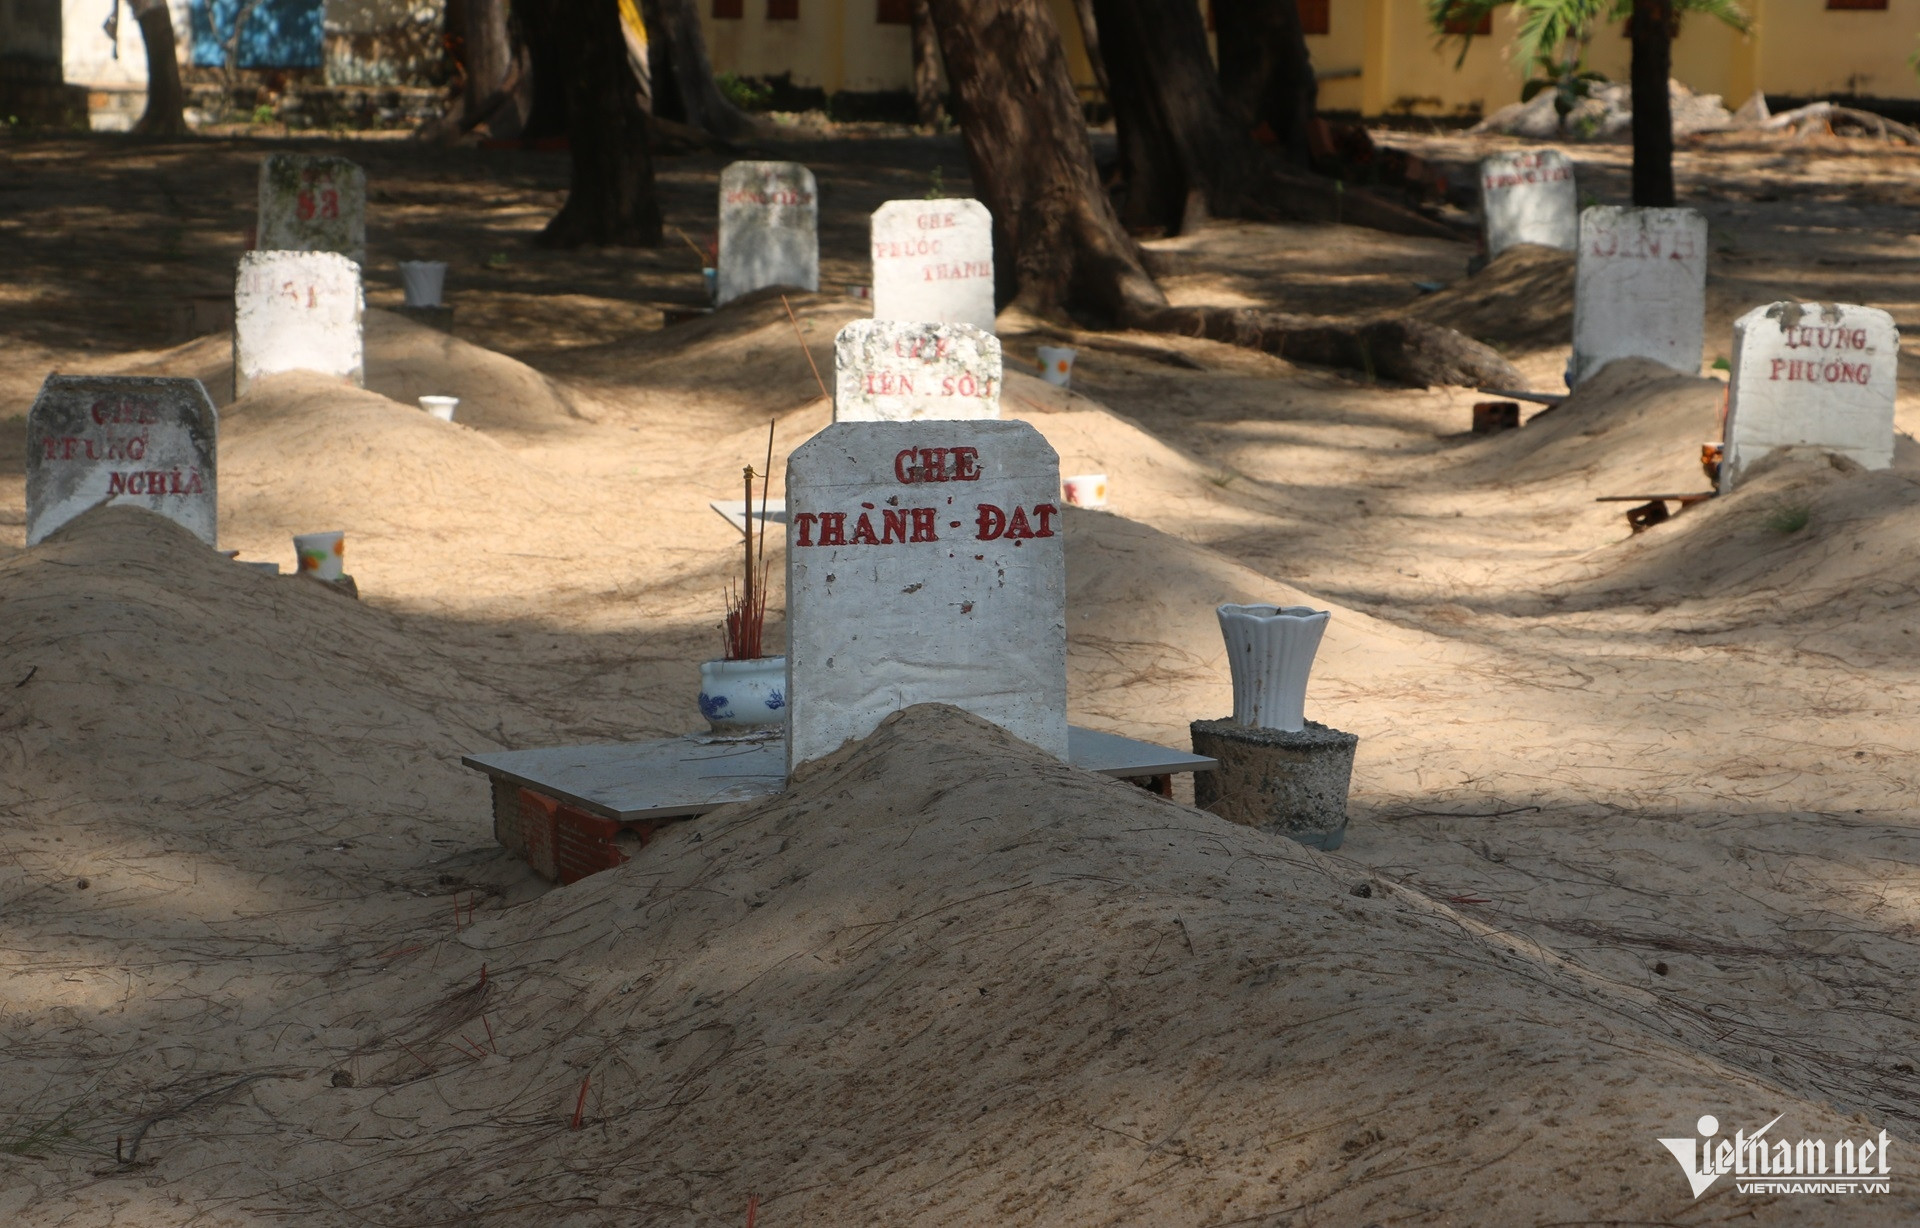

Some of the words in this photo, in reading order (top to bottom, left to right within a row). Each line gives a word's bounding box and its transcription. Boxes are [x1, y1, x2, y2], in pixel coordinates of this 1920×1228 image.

[895, 446, 983, 484] GHE
[794, 502, 939, 547] THÀNH
[975, 503, 1057, 547] ĐẠT
